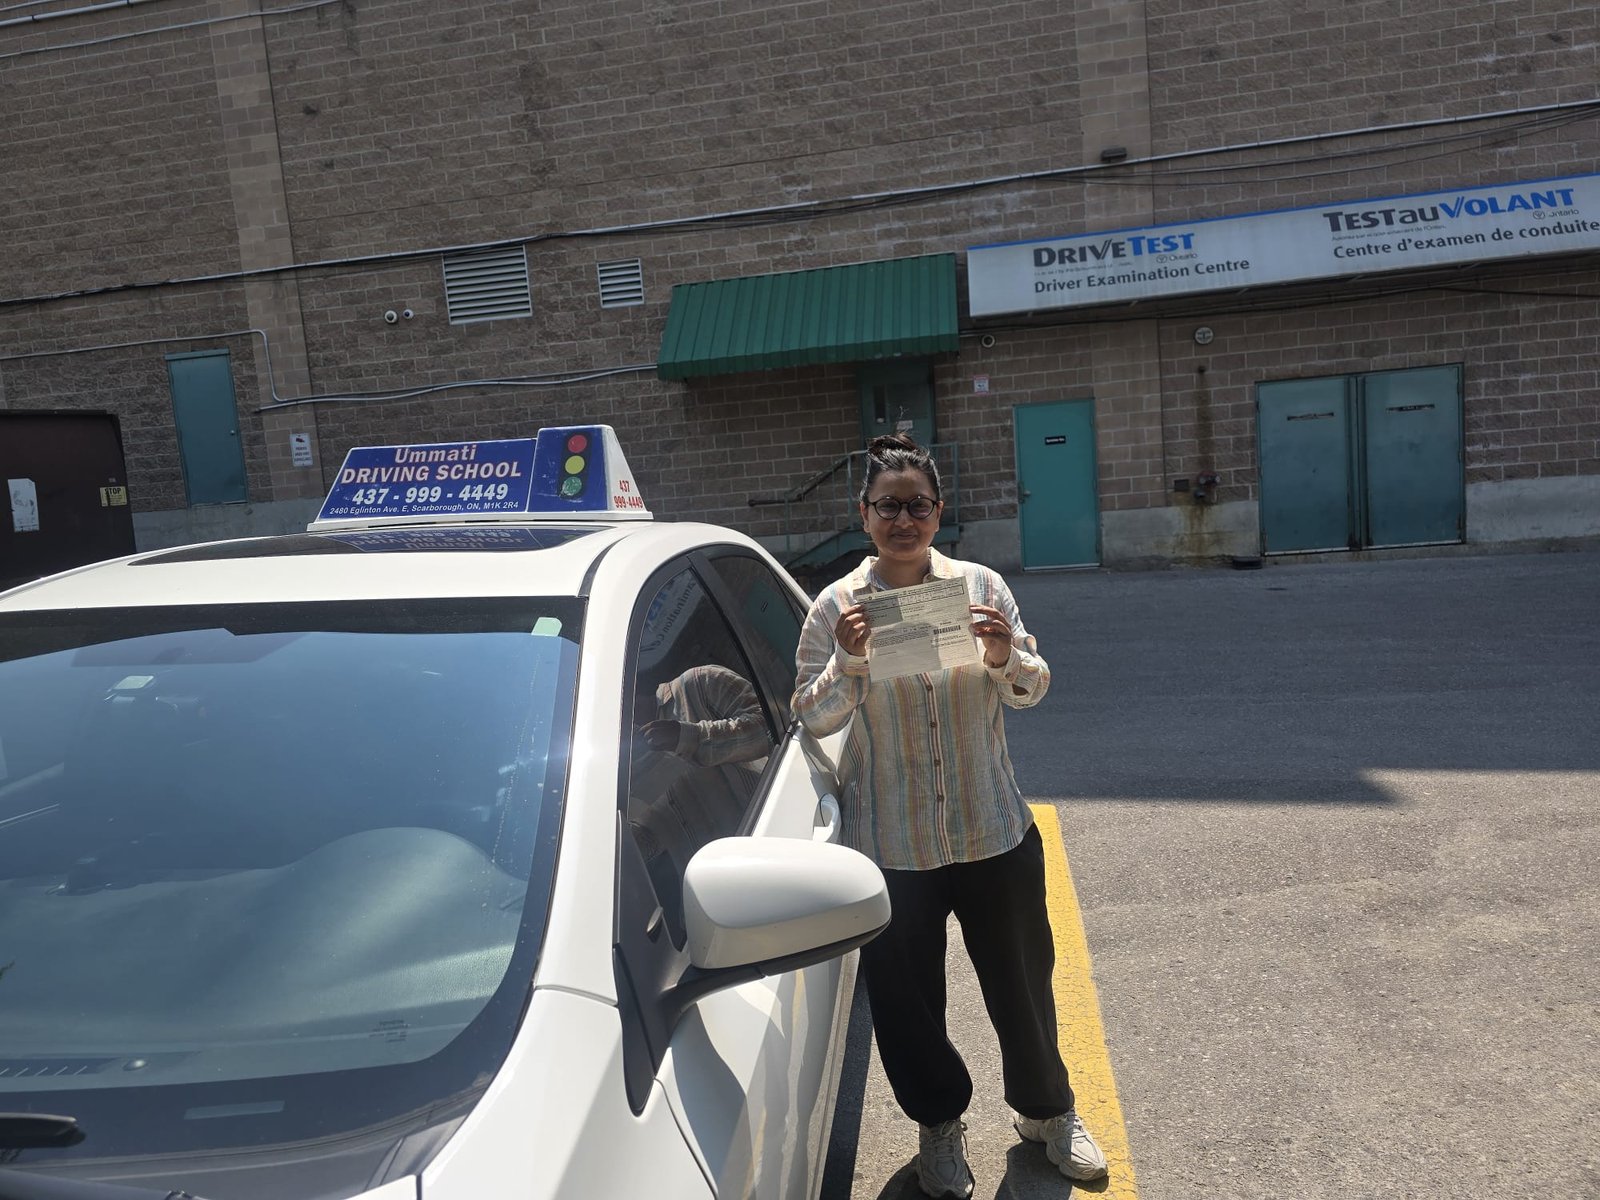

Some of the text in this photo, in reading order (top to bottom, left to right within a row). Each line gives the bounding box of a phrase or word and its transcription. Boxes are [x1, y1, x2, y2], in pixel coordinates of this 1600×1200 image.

[1333, 239, 1391, 259] Centre
[1398, 231, 1486, 251] d'examen
[1492, 226, 1514, 241] de
[1519, 219, 1600, 238] conduite
[1034, 279, 1082, 294] Driver
[1087, 266, 1189, 287] Examination
[1194, 258, 1250, 275] Centre
[394, 445, 478, 463] Ummati
[341, 461, 521, 484] DRIVING SCHOOL
[104, 487, 122, 495] STOP
[352, 488, 389, 505] 437
[405, 486, 442, 503] 999
[458, 483, 509, 501] 4449
[619, 479, 630, 492] 437
[329, 506, 349, 515] 2480
[349, 505, 381, 516] Eglinton
[382, 505, 400, 513] Ave.
[411, 502, 464, 513] Scarborough,
[483, 502, 501, 510] M1K
[503, 500, 519, 509] 2R4
